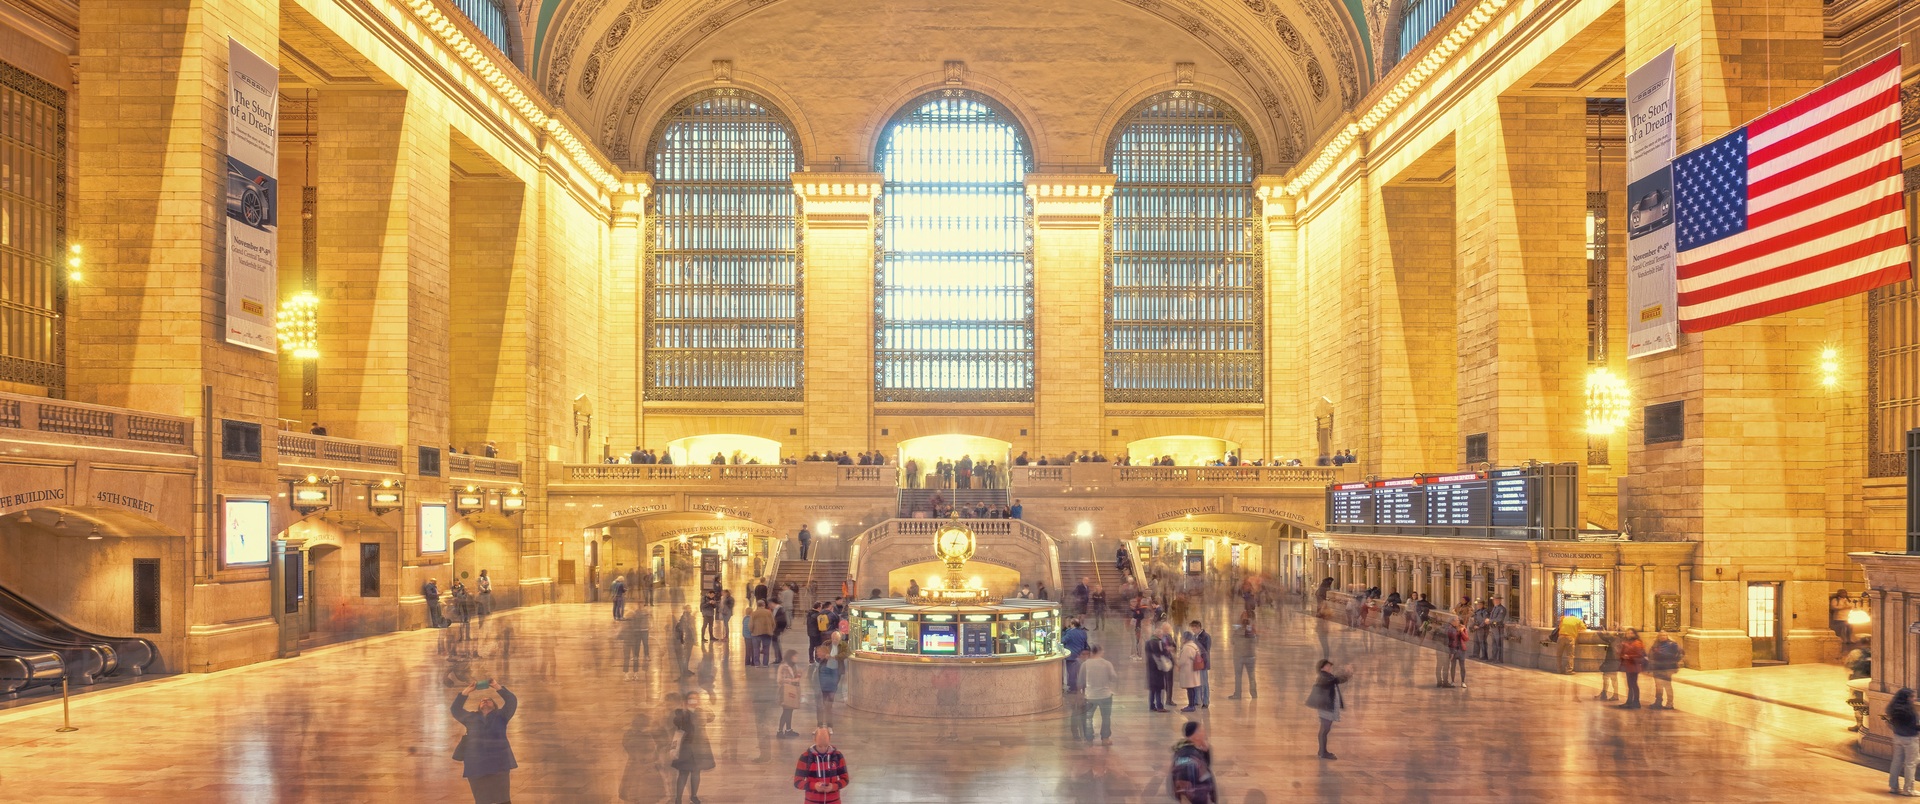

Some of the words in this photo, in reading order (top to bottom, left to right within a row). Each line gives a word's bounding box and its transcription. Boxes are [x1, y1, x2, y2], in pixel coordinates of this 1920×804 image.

[234, 88, 250, 109] The
[252, 100, 272, 125] Story
[1632, 114, 1646, 128] The
[1648, 99, 1670, 119] Story
[231, 105, 240, 118] of
[241, 112, 246, 122] a
[248, 112, 275, 137] Dream
[1628, 129, 1638, 143] of
[1639, 130, 1643, 139] a
[1645, 112, 1673, 136] Dream
[231, 245, 243, 255] Grand
[234, 236, 258, 252] November
[1633, 249, 1656, 262] November
[15, 488, 65, 505] BUILDING
[97, 491, 120, 504] 45TH
[122, 496, 154, 513] STREET
[613, 507, 641, 517] TRACKS
[693, 503, 736, 515] LEXINGTON
[737, 510, 751, 518] AVE
[1157, 506, 1200, 520] LEXINGTON
[1241, 505, 1266, 514] TICKET
[1268, 508, 1305, 522] MACHINES
[1141, 527, 1163, 535] STREET
